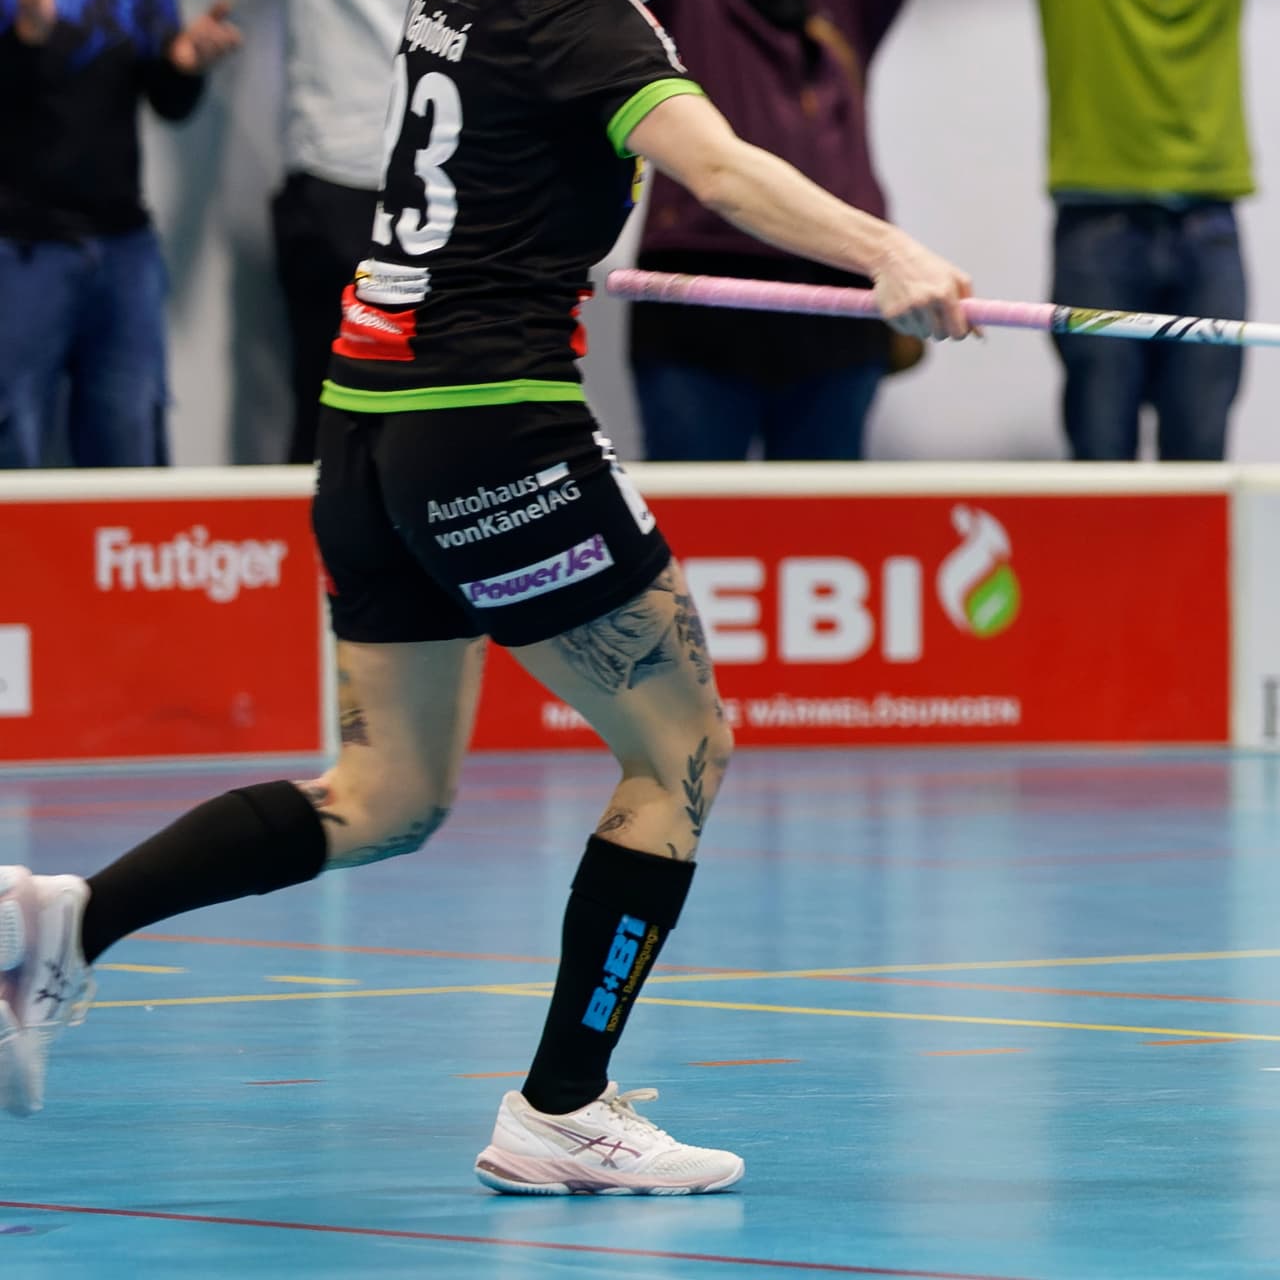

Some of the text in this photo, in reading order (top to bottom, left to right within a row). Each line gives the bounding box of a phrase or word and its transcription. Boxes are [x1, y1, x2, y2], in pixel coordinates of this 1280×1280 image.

[427, 474, 540, 523] Autohaus
[94, 523, 288, 604] Frutiger
[684, 557, 922, 663] EBI
